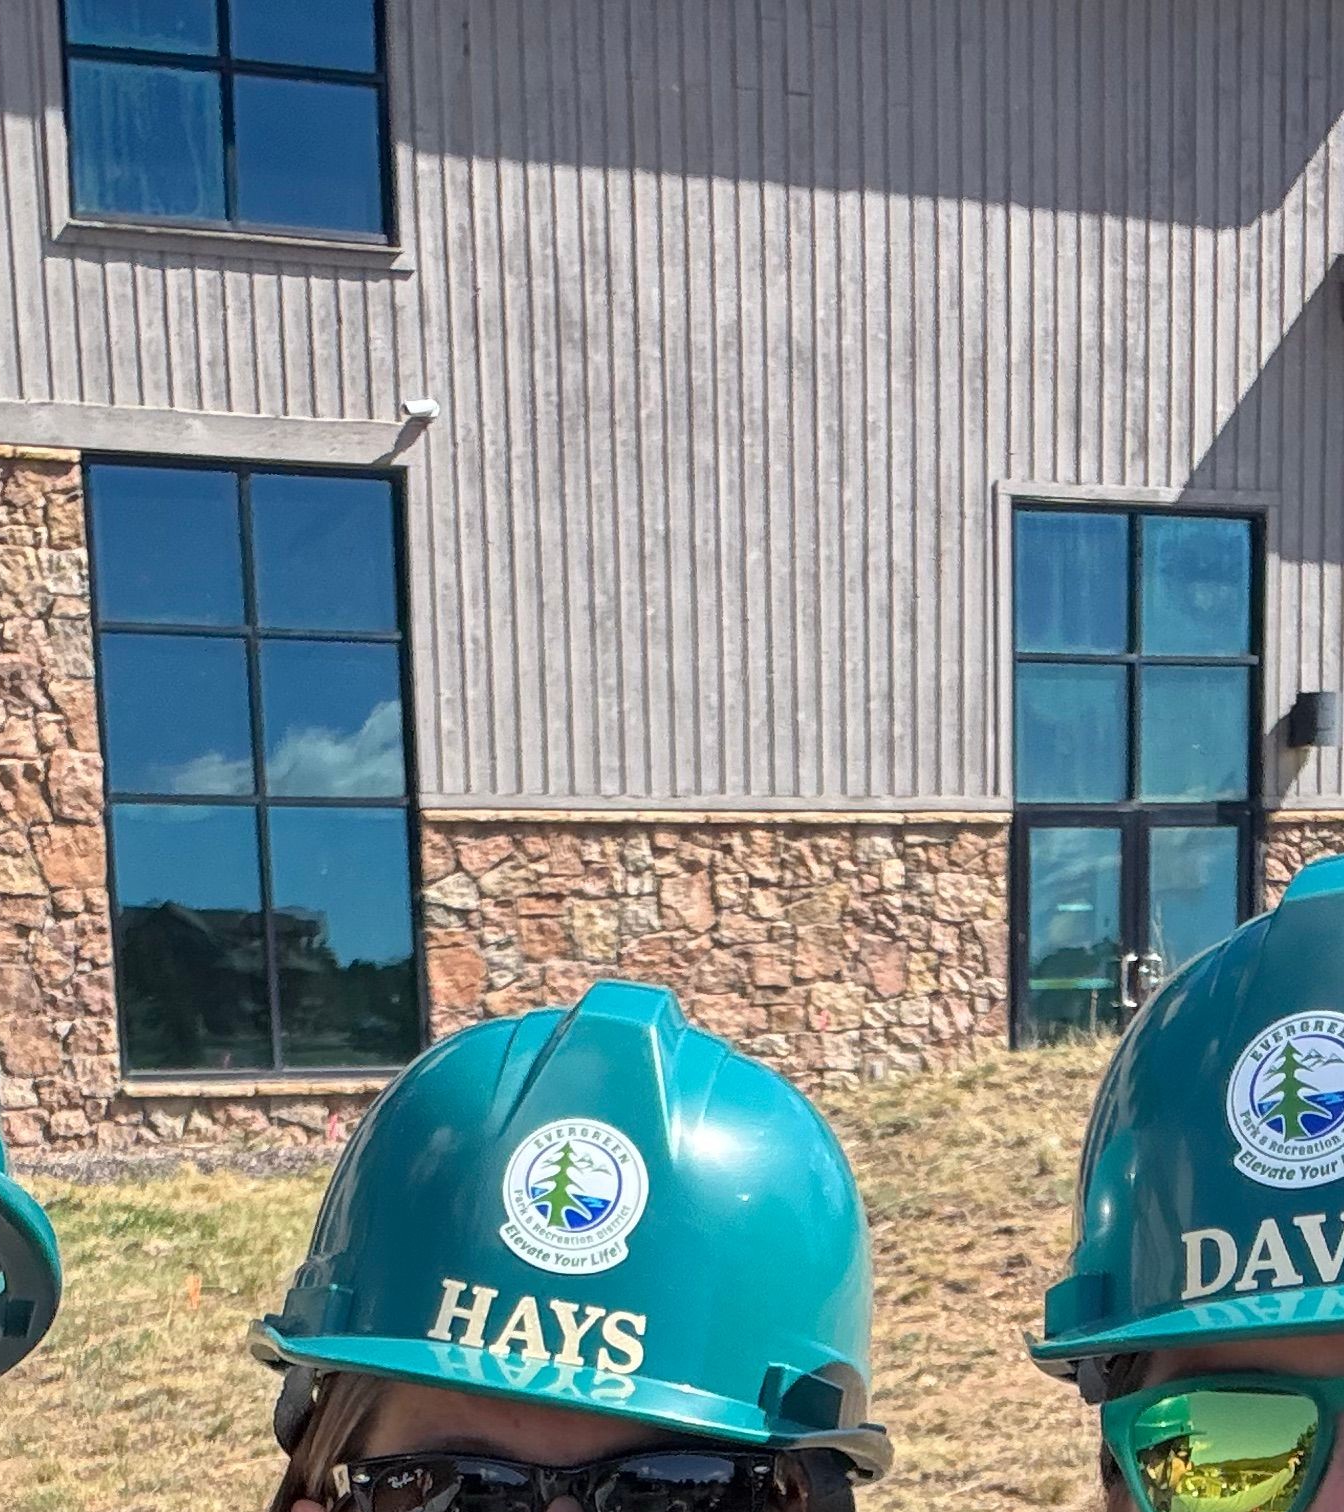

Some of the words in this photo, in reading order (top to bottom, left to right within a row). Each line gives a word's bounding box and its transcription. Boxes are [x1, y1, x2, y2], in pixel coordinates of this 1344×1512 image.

[533, 1126, 631, 1165] EVERGREEN
[1239, 1108, 1262, 1140] Park
[1268, 1134, 1342, 1156] Recreation
[1238, 1149, 1297, 1181] Elevate
[1299, 1159, 1338, 1180] Your
[513, 1188, 530, 1216] Park
[532, 1221, 595, 1246] Recreation
[596, 1204, 632, 1240] District
[504, 1223, 552, 1262] Elevate
[554, 1252, 589, 1267] Your
[589, 1240, 623, 1267] Life!
[427, 1278, 648, 1375] HAYS
